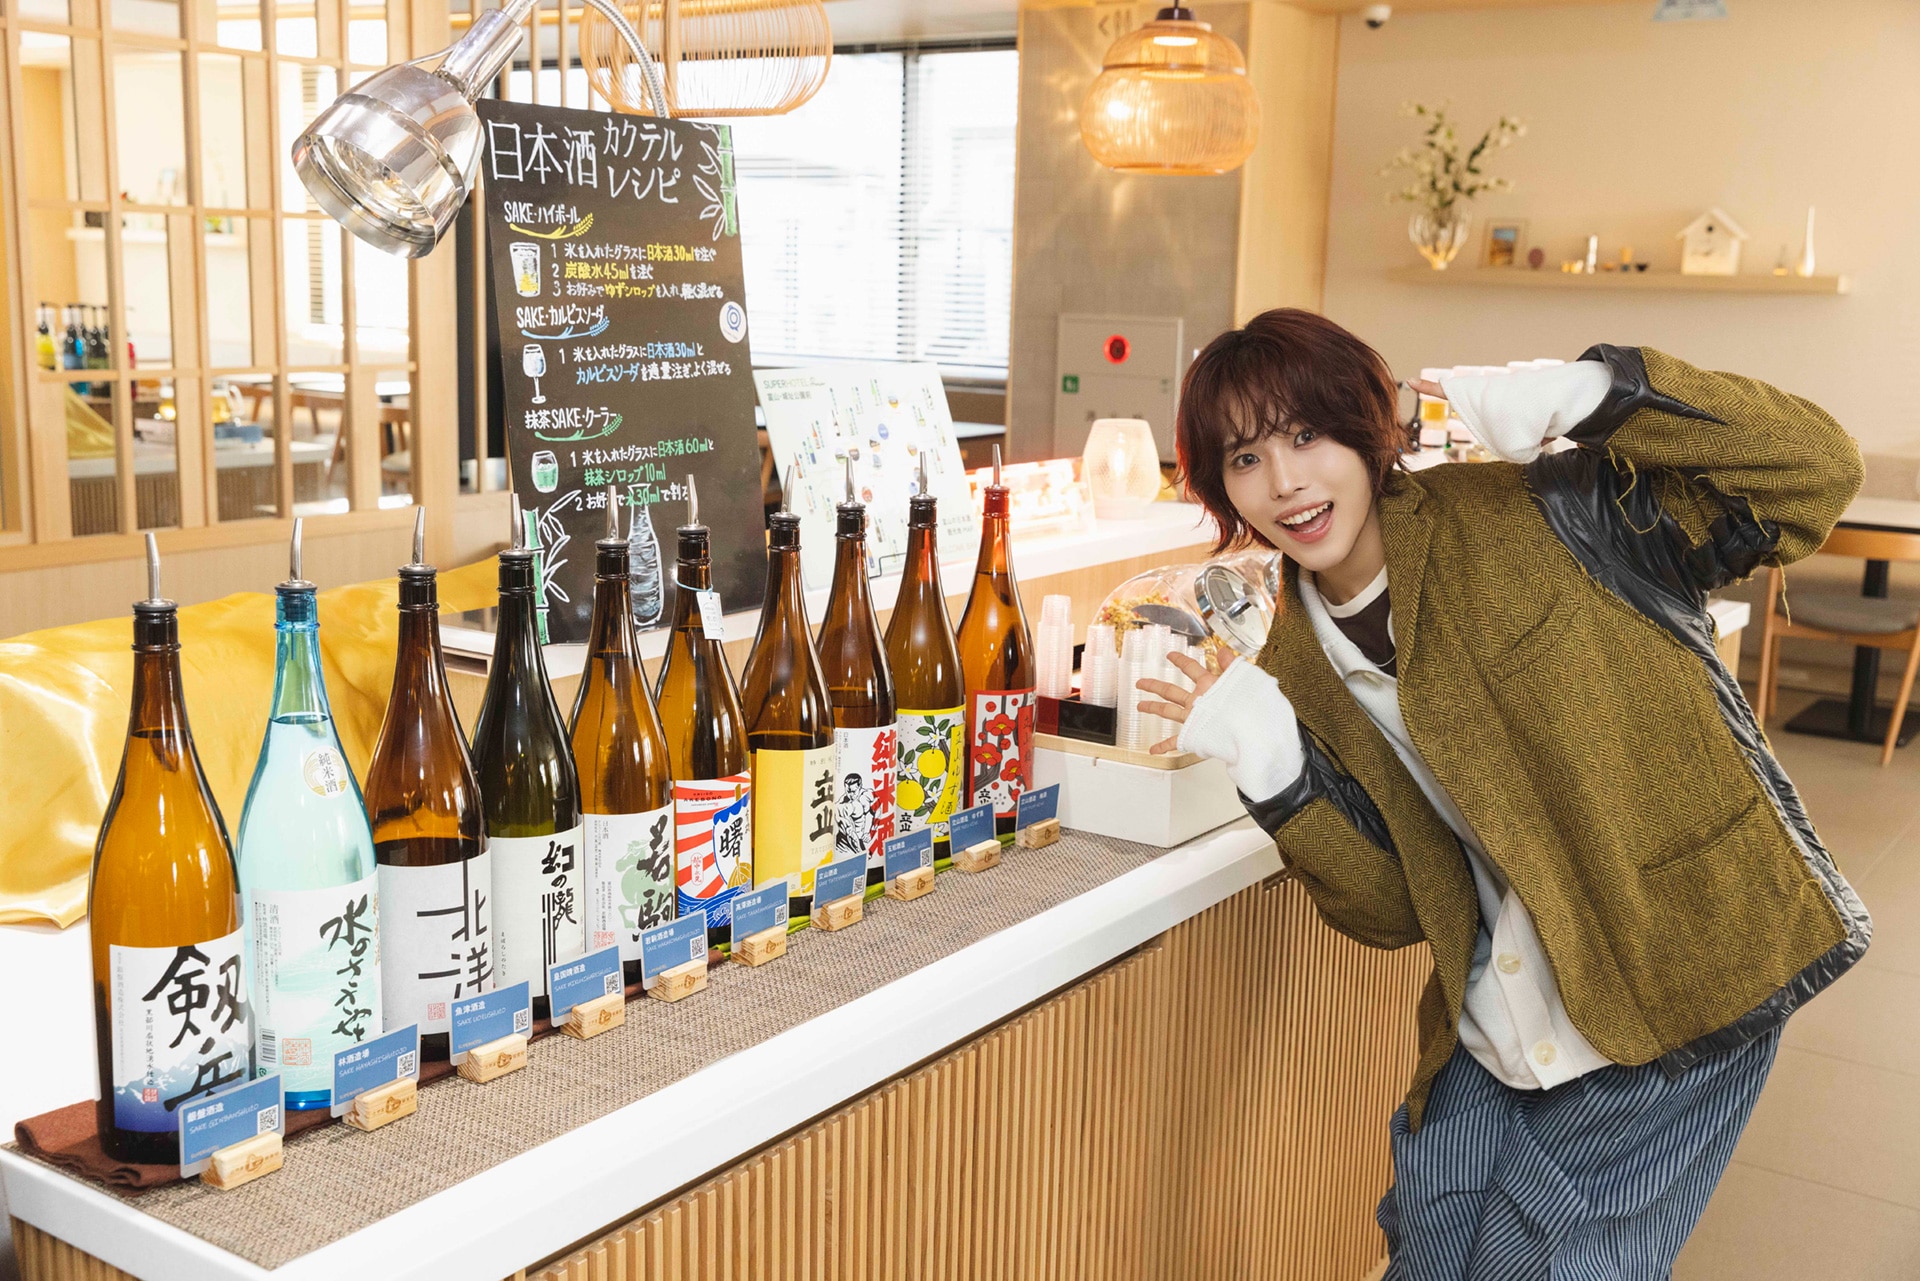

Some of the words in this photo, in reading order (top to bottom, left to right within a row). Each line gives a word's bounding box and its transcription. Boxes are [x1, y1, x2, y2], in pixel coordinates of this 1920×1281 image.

[487, 119, 598, 188] 日本酒
[603, 117, 684, 163] カクテル
[606, 165, 682, 204] レシピ
[551, 243, 557, 258] 1
[552, 263, 559, 278] 2
[564, 261, 654, 280] 炭酸水45mlを注ぐ
[553, 280, 561, 297] 3
[559, 347, 565, 364] 1
[570, 451, 576, 467] 1
[584, 462, 667, 487] 抹茶シロップ10ml
[574, 497, 583, 511] 2
[318, 753, 339, 793] 純米酒
[683, 795, 723, 803] AKEBONO
[869, 729, 897, 857] 純米酒
[809, 769, 834, 842] 立山
[900, 812, 912, 832] 立山
[719, 816, 744, 859] 曙
[417, 860, 494, 999] 北洋
[455, 1000, 486, 1016] 魚津酒造
[456, 1018, 472, 1027] SAKE
[338, 1066, 355, 1078] SAKE
[189, 1122, 207, 1135] SAKE
